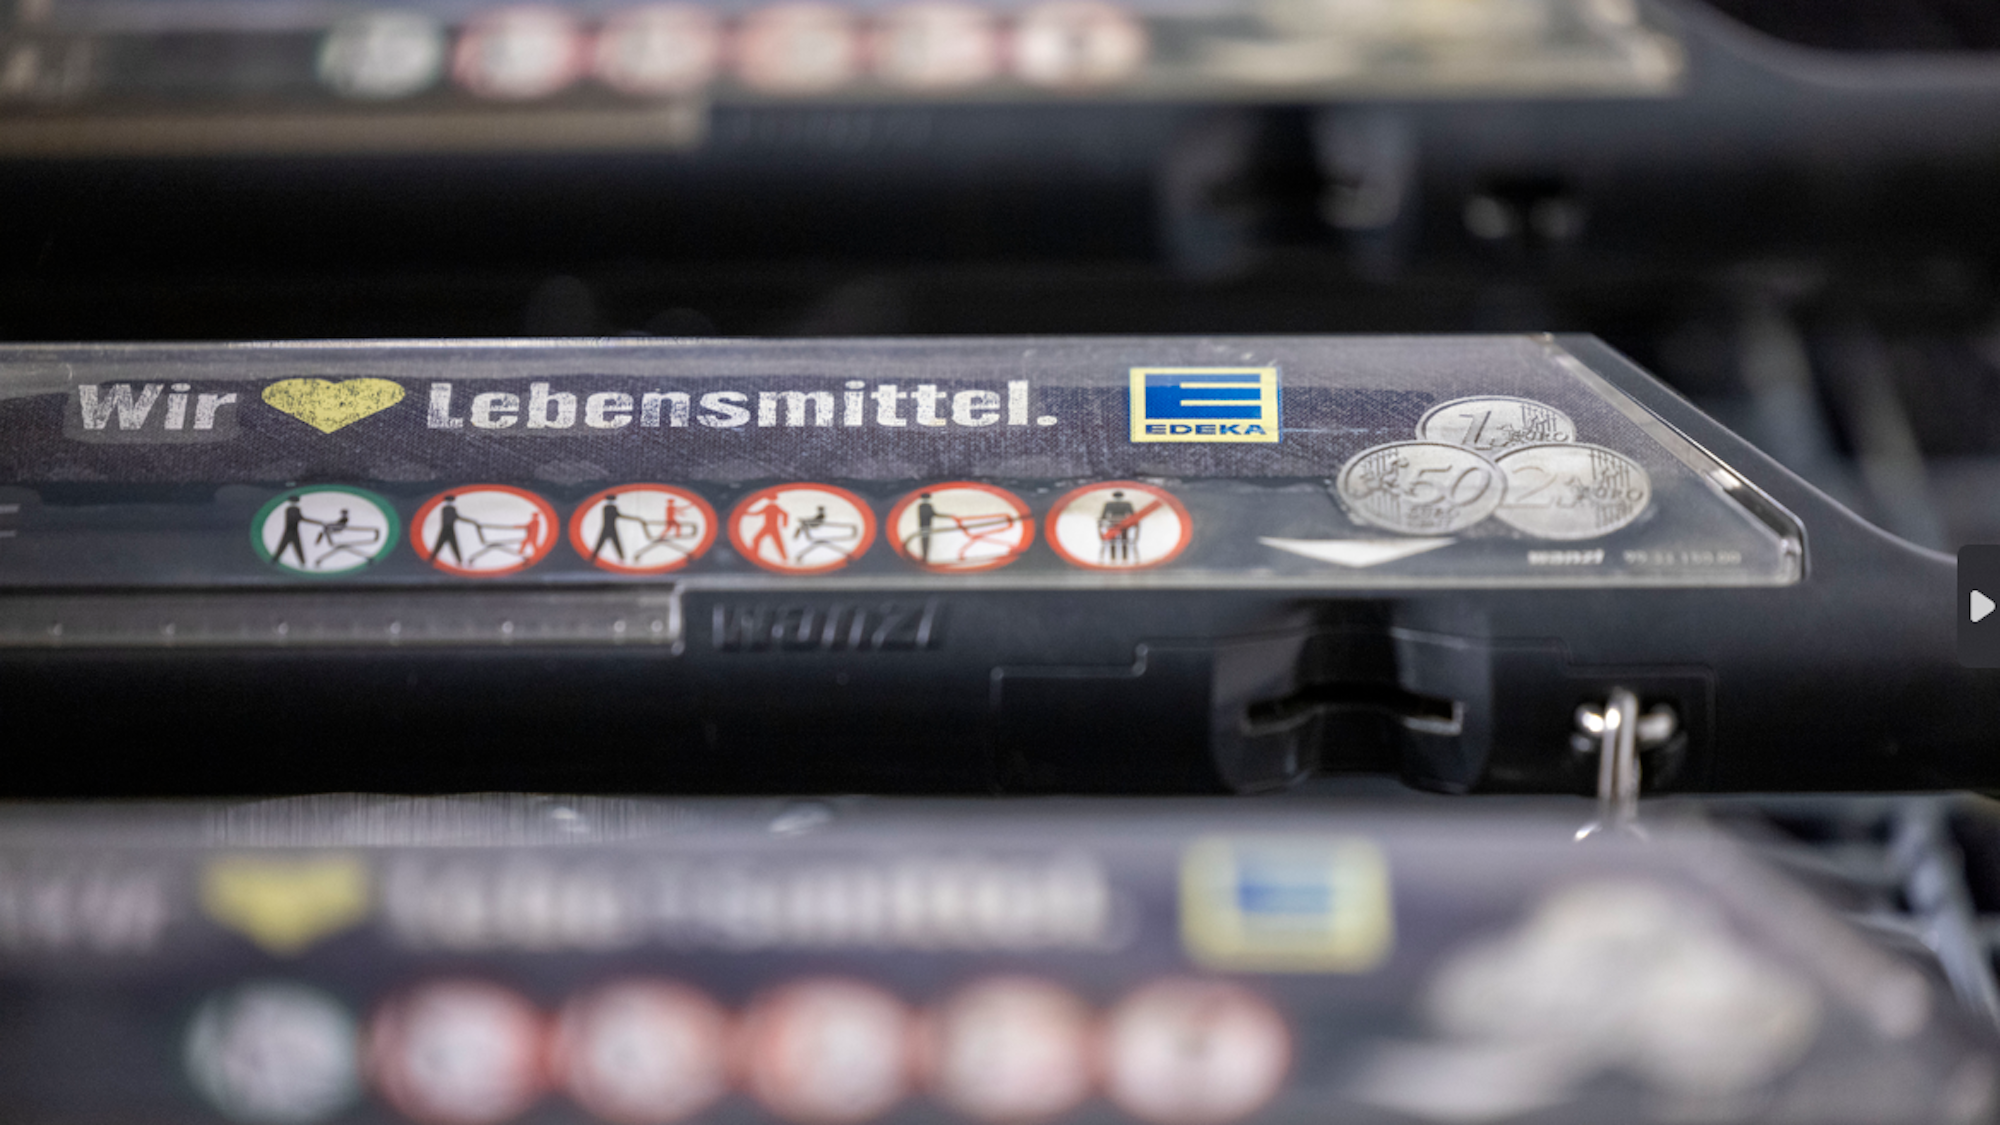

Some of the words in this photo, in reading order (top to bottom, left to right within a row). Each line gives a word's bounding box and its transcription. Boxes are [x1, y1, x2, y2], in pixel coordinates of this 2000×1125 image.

[78, 383, 237, 430] Wir
[427, 380, 1058, 429] Lebensmittel.
[1145, 424, 1266, 435] EDEKA
[1404, 464, 1492, 507] 50
[1499, 465, 1558, 508] 2
